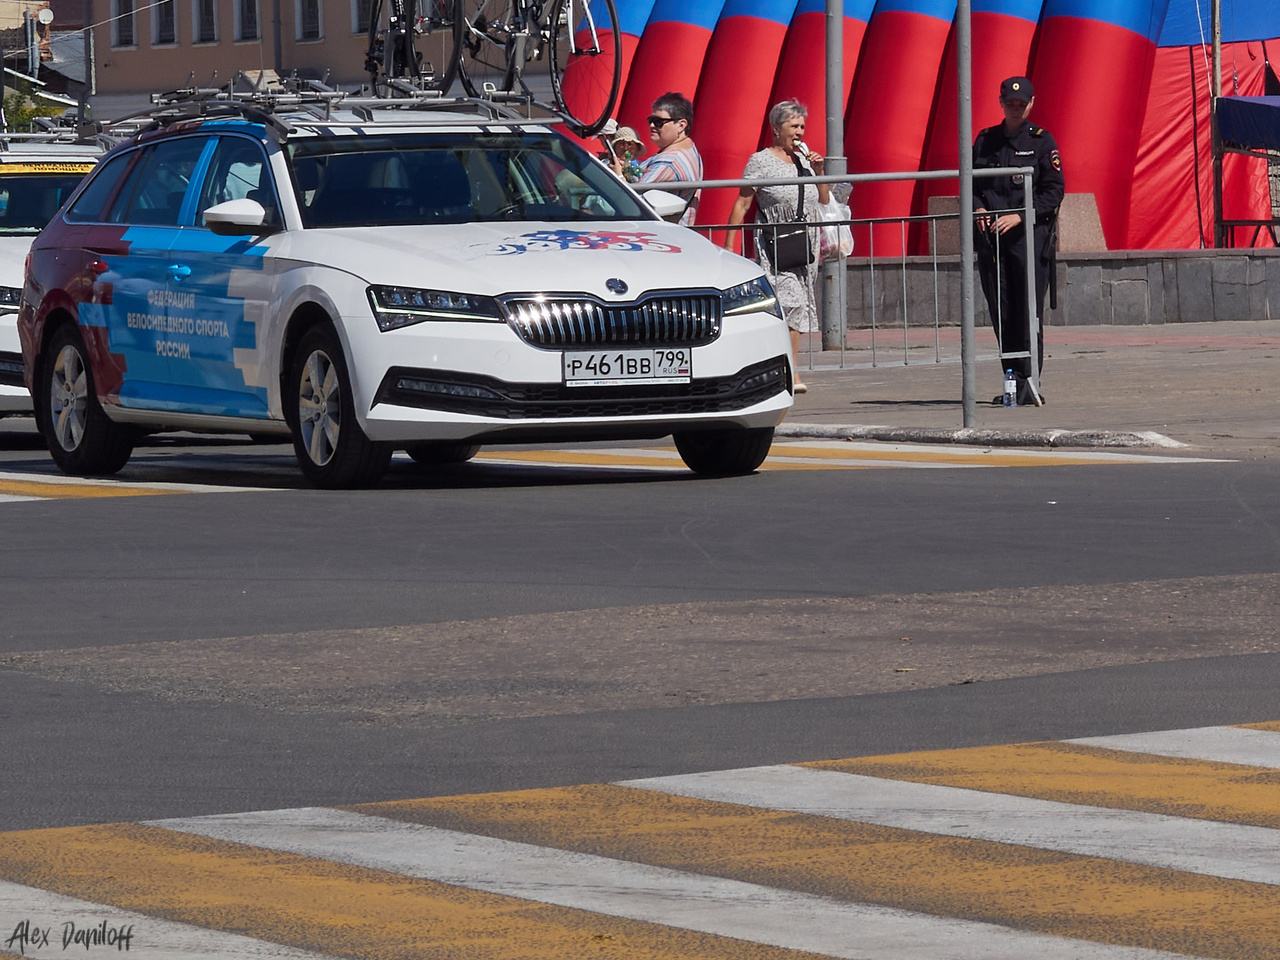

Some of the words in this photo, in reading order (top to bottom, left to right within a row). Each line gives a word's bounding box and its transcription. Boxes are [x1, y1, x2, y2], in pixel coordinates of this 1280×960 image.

[147, 289, 195, 309] ФЕДЕРАЦИЯ
[127, 312, 195, 334] ВЕЛОСИПЕДНОГО
[196, 319, 229, 338] СПОРТА
[156, 340, 191, 359] РОССИИ
[655, 350, 685, 368] 799
